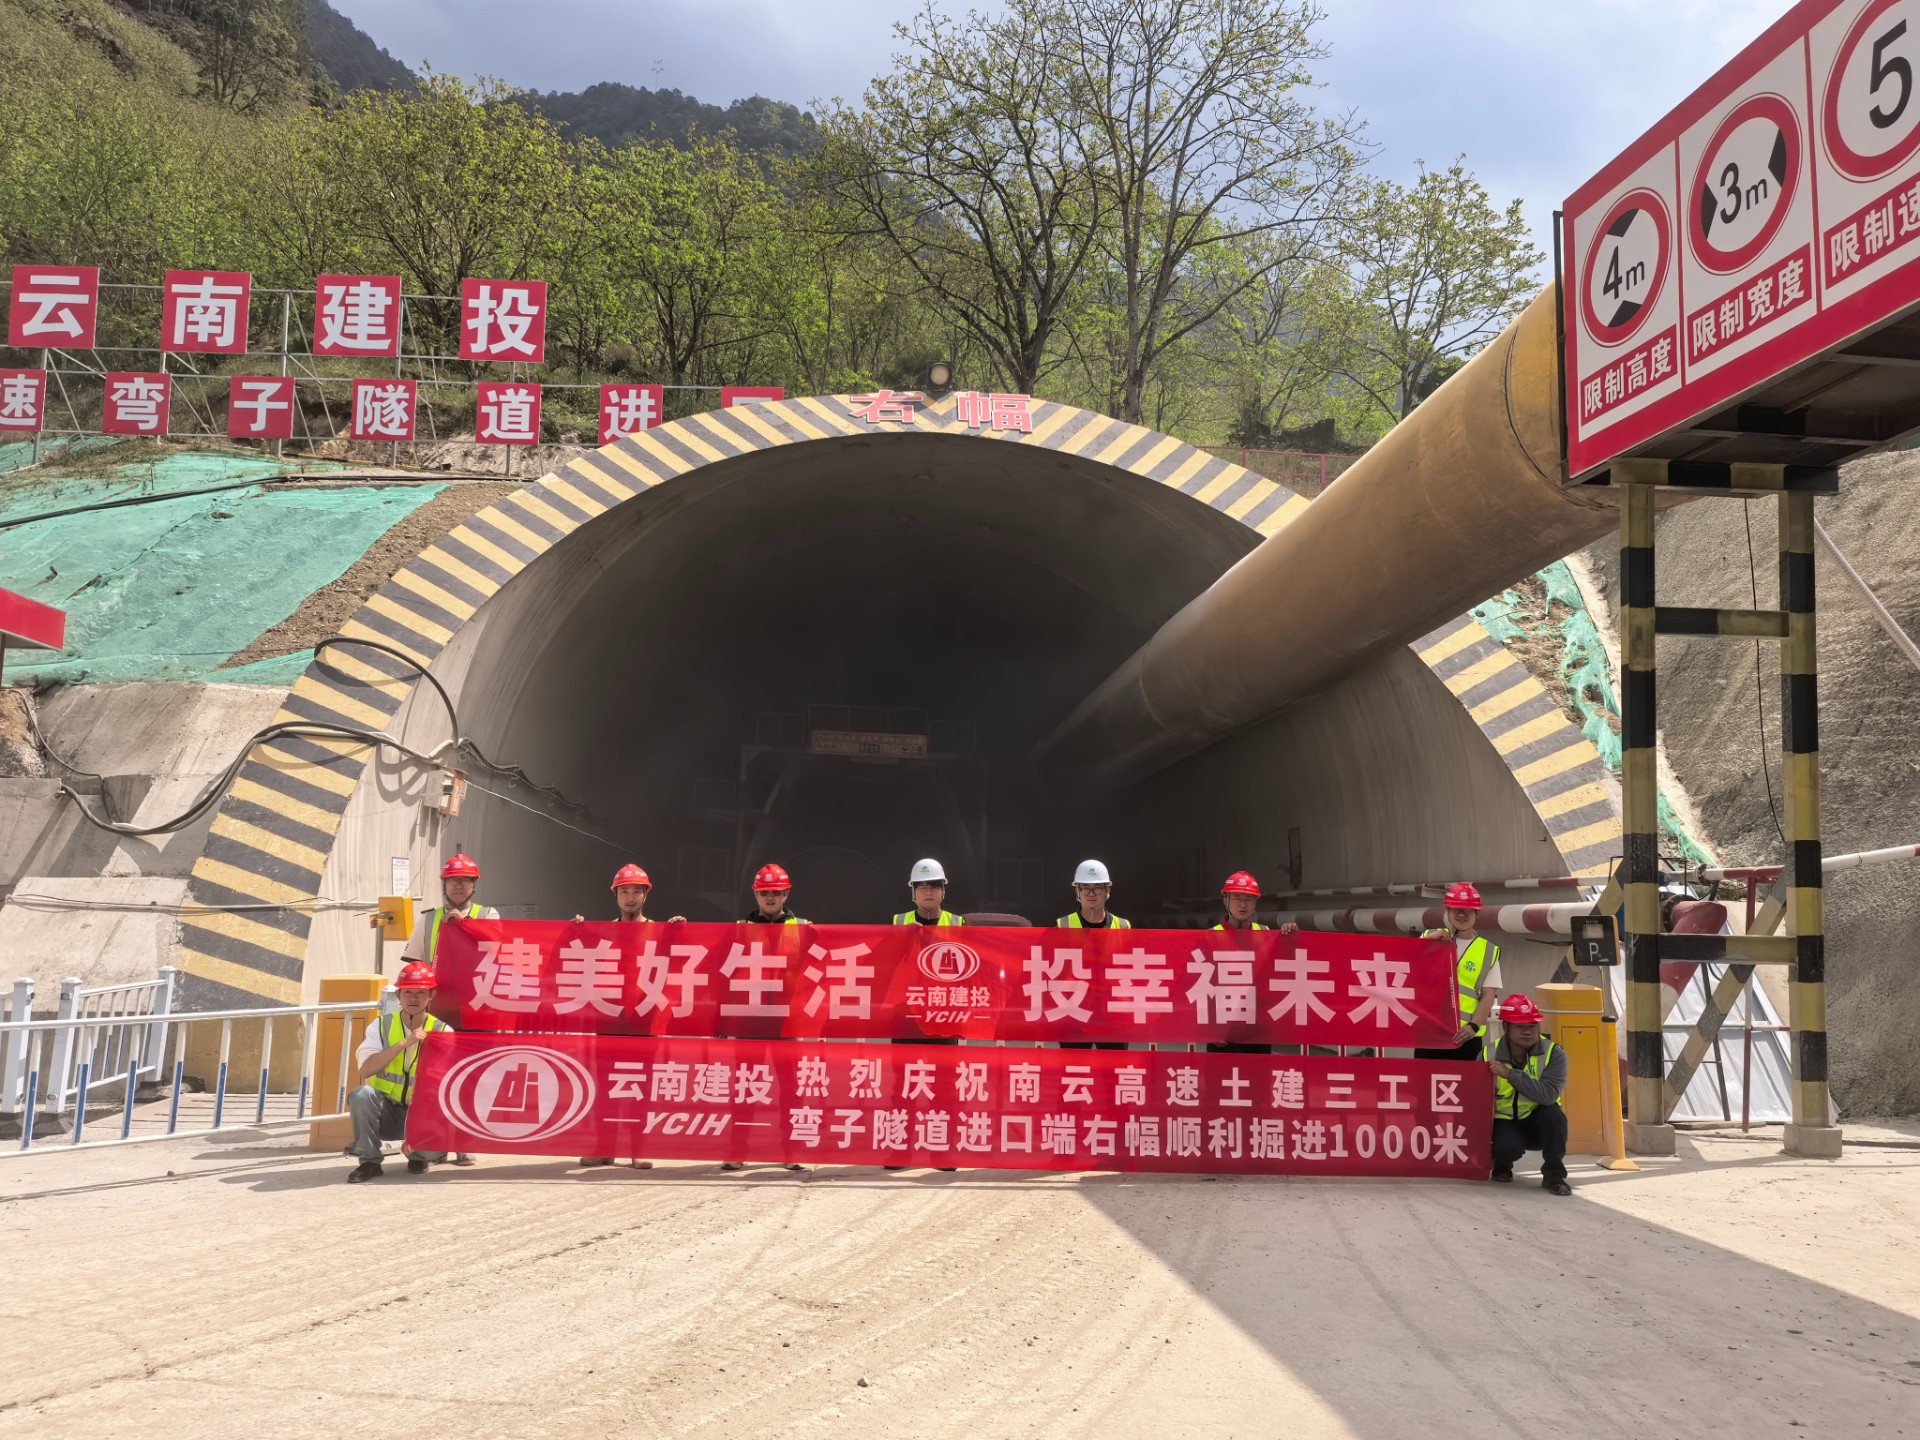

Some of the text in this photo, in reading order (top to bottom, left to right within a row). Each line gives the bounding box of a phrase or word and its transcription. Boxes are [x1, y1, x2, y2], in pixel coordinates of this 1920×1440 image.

[1718, 162, 1768, 225] 3m
[1602, 246, 1645, 300] 4m
[18, 274, 542, 357] 云南建投
[1693, 255, 1805, 357] 限制宽度
[1584, 337, 1673, 418] 限制高度
[0, 374, 773, 440] 速弯子隧道进
[849, 390, 1032, 432] 右幅
[1589, 942, 1599, 962] P
[469, 937, 1418, 1028] 建美好生活 投幸福未来
[906, 986, 991, 1007] 云南建投
[925, 1011, 972, 1023] YCIH
[608, 1061, 774, 1105] 云南建投
[796, 1056, 1464, 1113] 热烈庆祝南云高速土建三工区
[642, 1112, 732, 1136] YCIH
[789, 1105, 1469, 1165] 弯子隧道进口端右幅顺利掘进1000米
